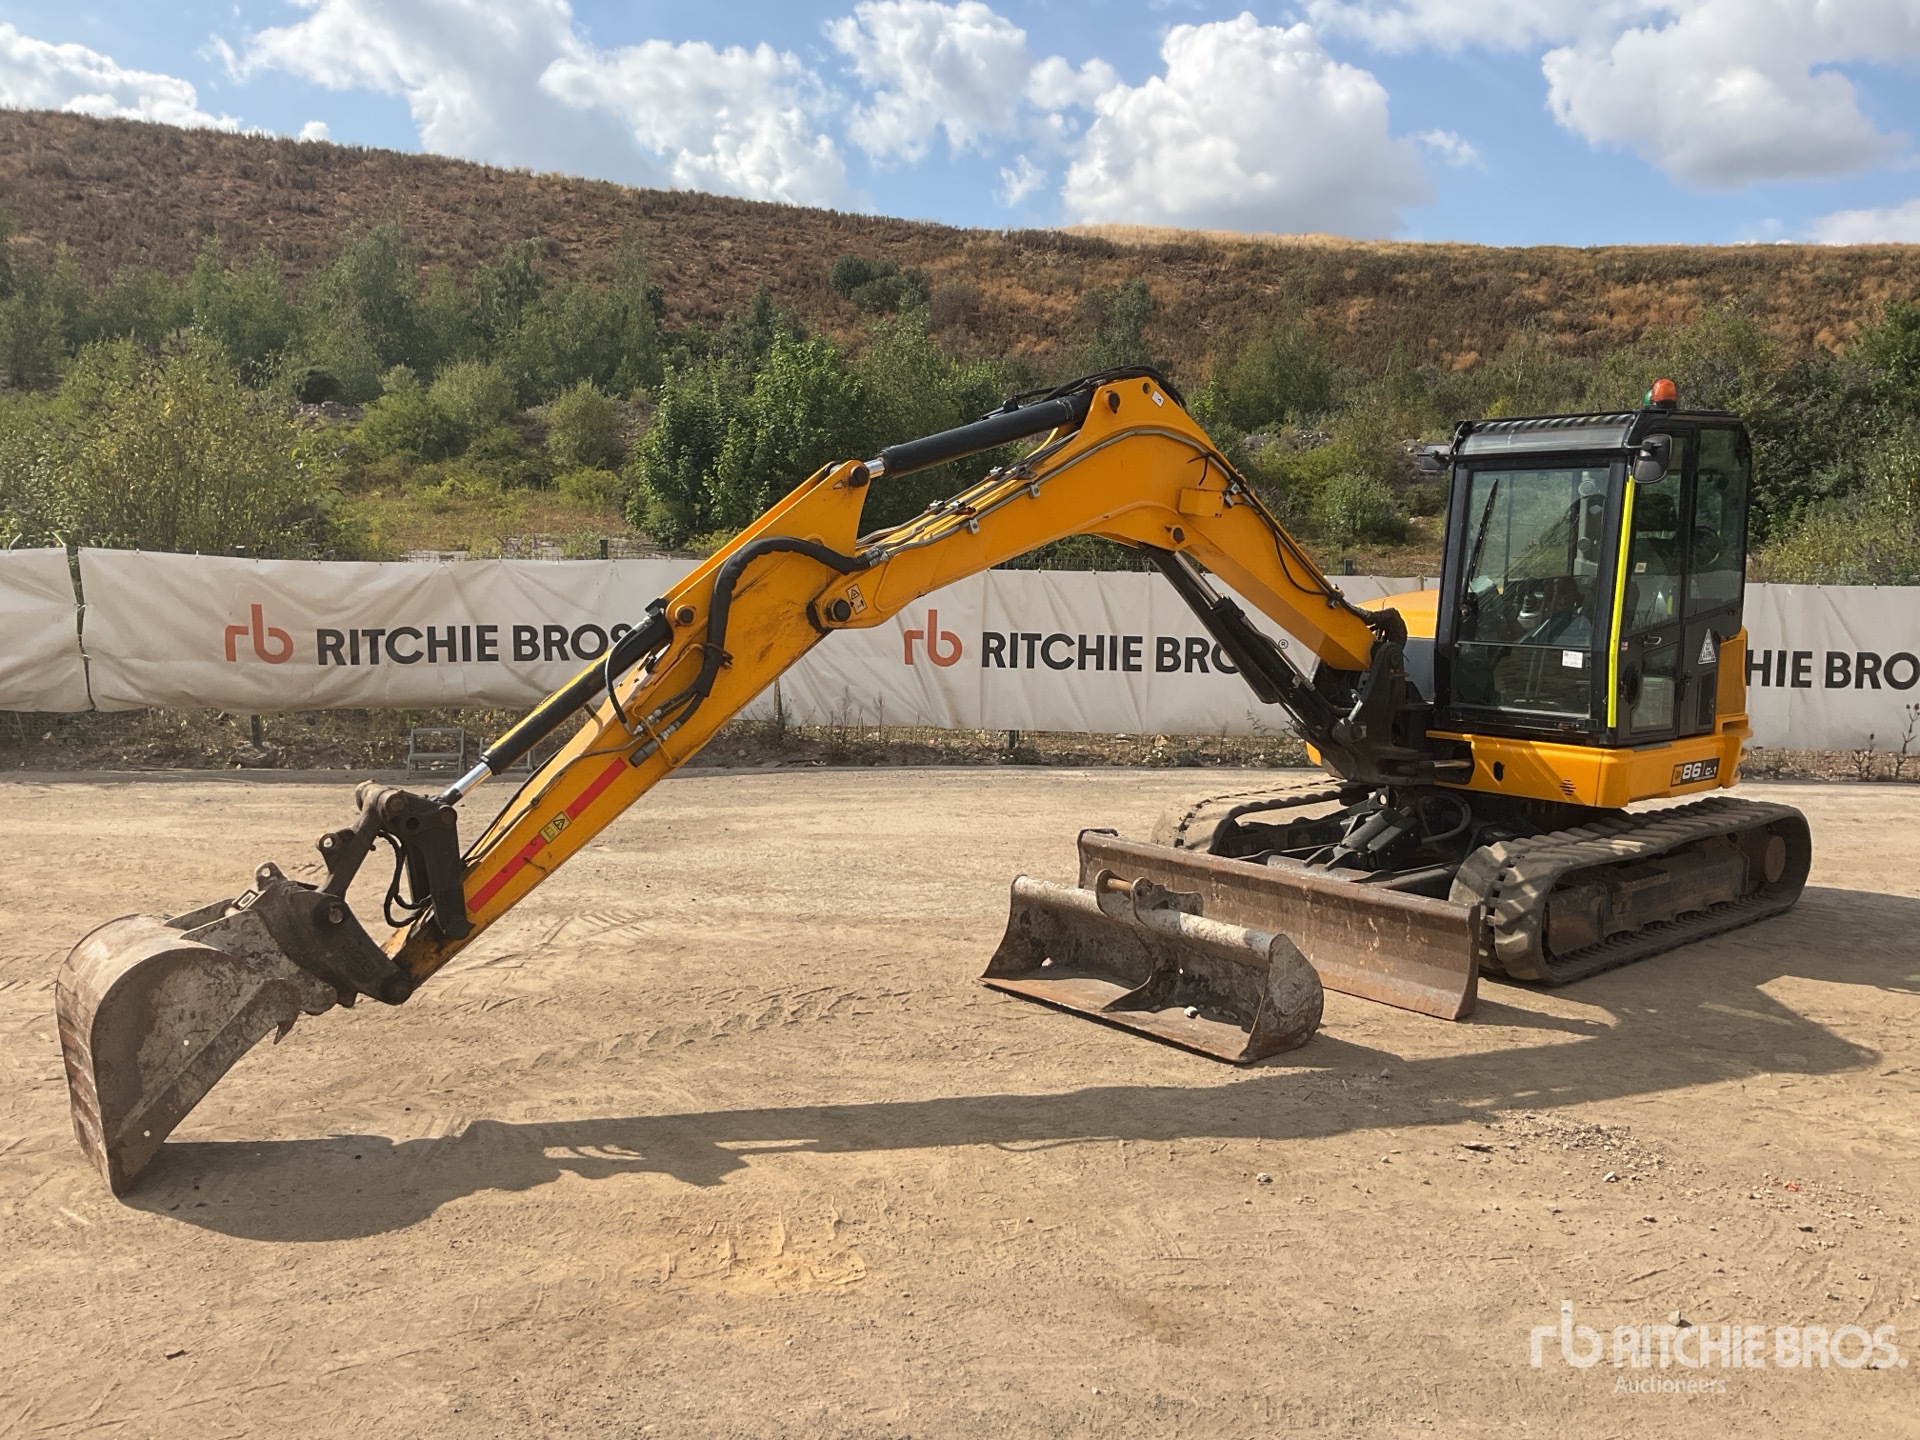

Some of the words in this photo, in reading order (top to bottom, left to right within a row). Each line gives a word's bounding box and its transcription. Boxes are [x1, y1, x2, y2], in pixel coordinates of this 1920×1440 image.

[316, 625, 499, 666] RITCHIE
[981, 631, 1143, 672] RITCHIE
[1155, 636, 1240, 675] BRO
[1824, 651, 1920, 690] BRO
[1682, 762, 1702, 780] 86
